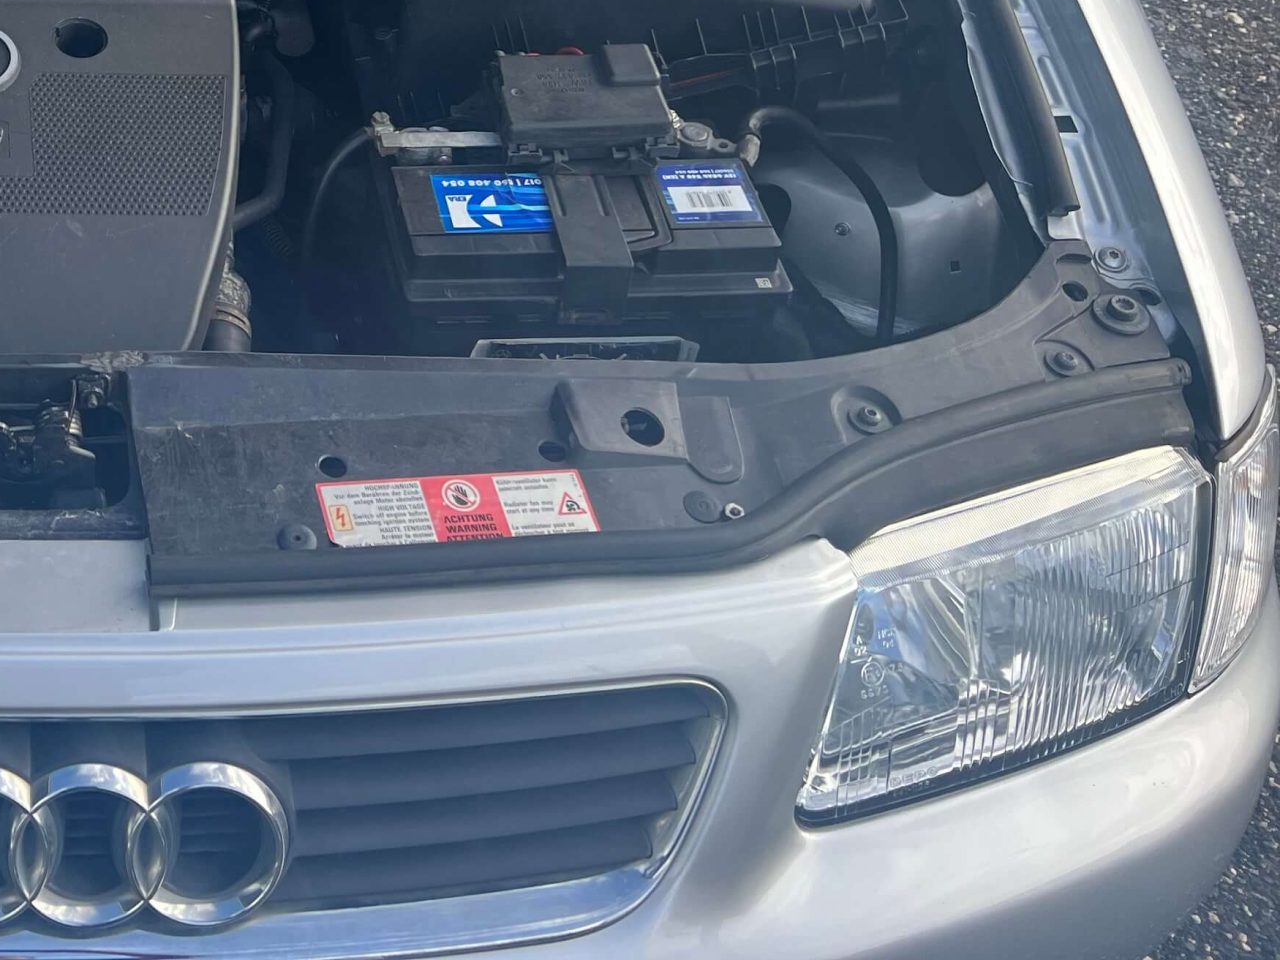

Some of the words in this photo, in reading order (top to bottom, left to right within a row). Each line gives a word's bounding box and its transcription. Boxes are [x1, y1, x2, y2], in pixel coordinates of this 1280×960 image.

[441, 179, 467, 188] 054
[375, 497, 395, 505] Motor
[541, 500, 554, 508] may
[396, 502, 426, 511] VOLTAGE
[528, 506, 540, 515] any
[541, 505, 555, 513] time
[352, 512, 375, 521] Switch
[386, 511, 407, 520] engine
[408, 510, 428, 518] before
[443, 513, 494, 524] ACHTUNG
[407, 517, 430, 525] system
[379, 525, 402, 533] HAUTE
[403, 523, 433, 532] TENSION
[445, 522, 498, 534] WARNING
